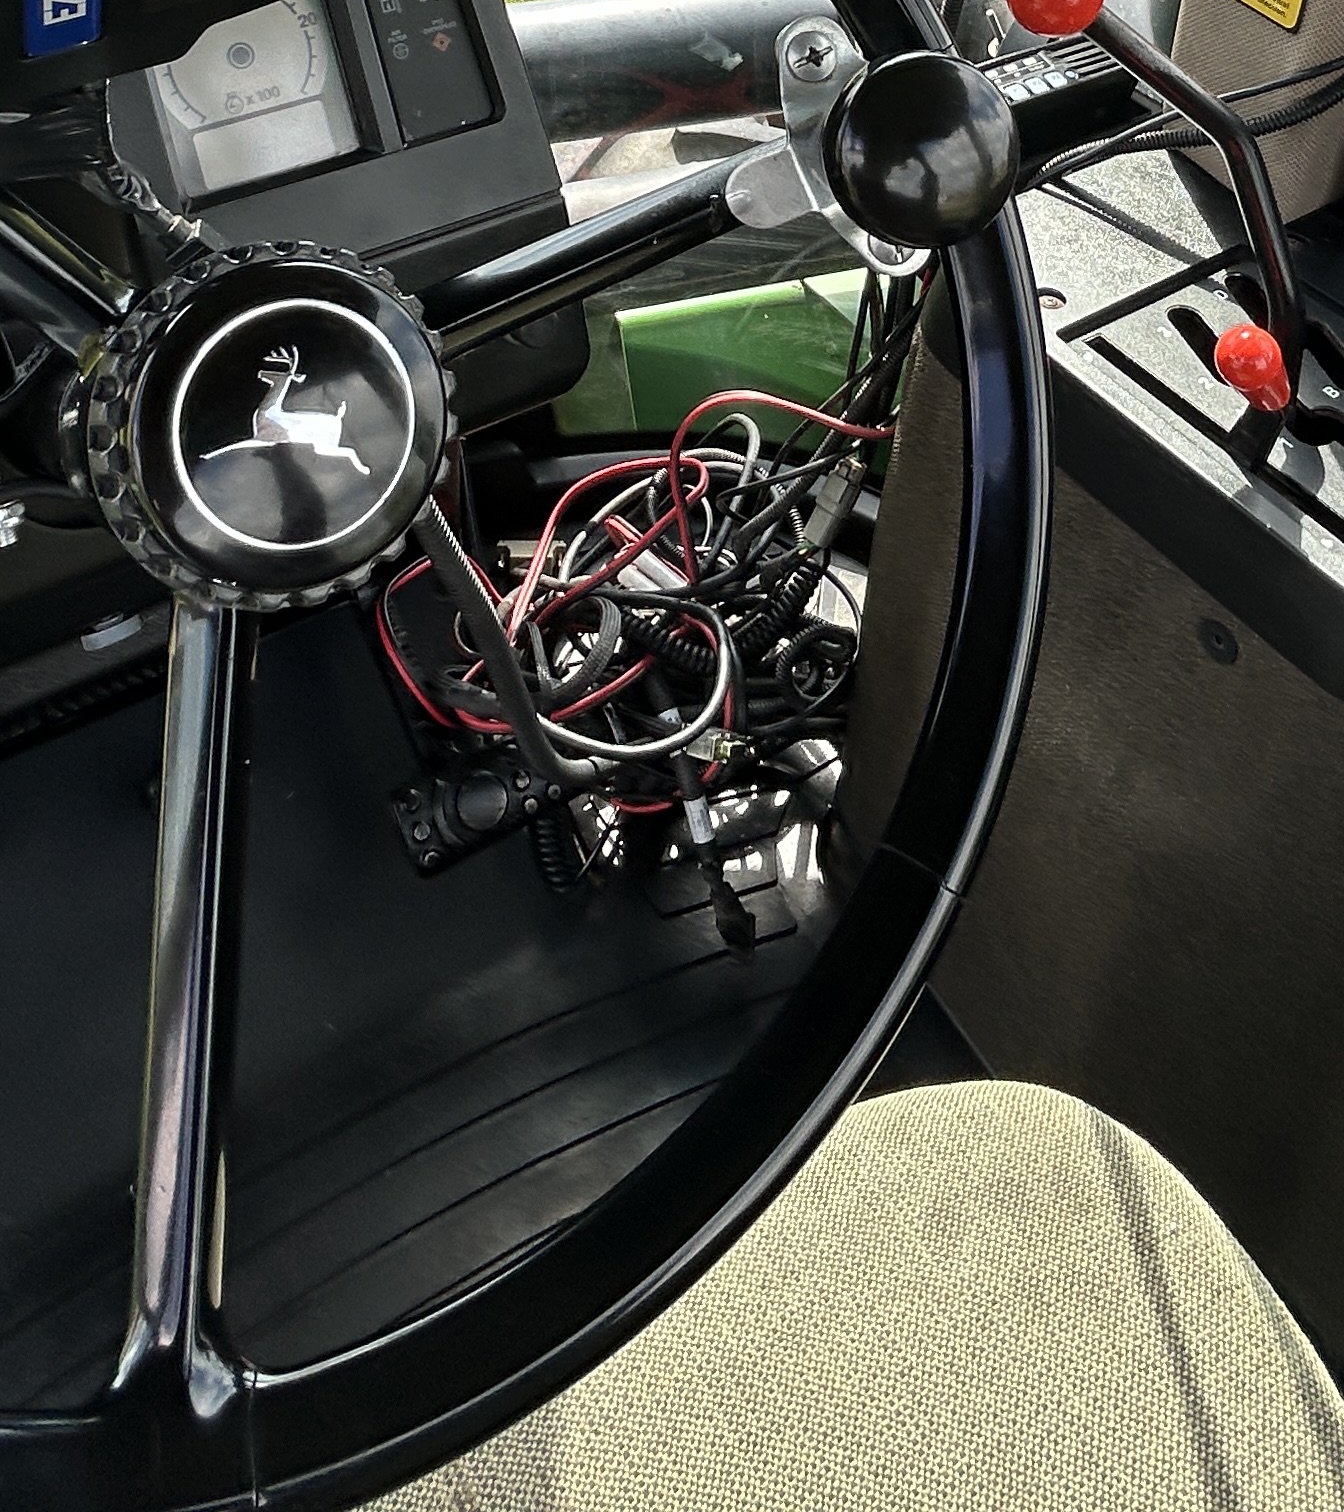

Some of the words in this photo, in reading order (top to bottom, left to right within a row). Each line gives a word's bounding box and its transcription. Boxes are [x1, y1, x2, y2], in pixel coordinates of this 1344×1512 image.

[297, 12, 318, 28] 20
[256, 86, 280, 102] 100
[1322, 385, 1340, 400] B
